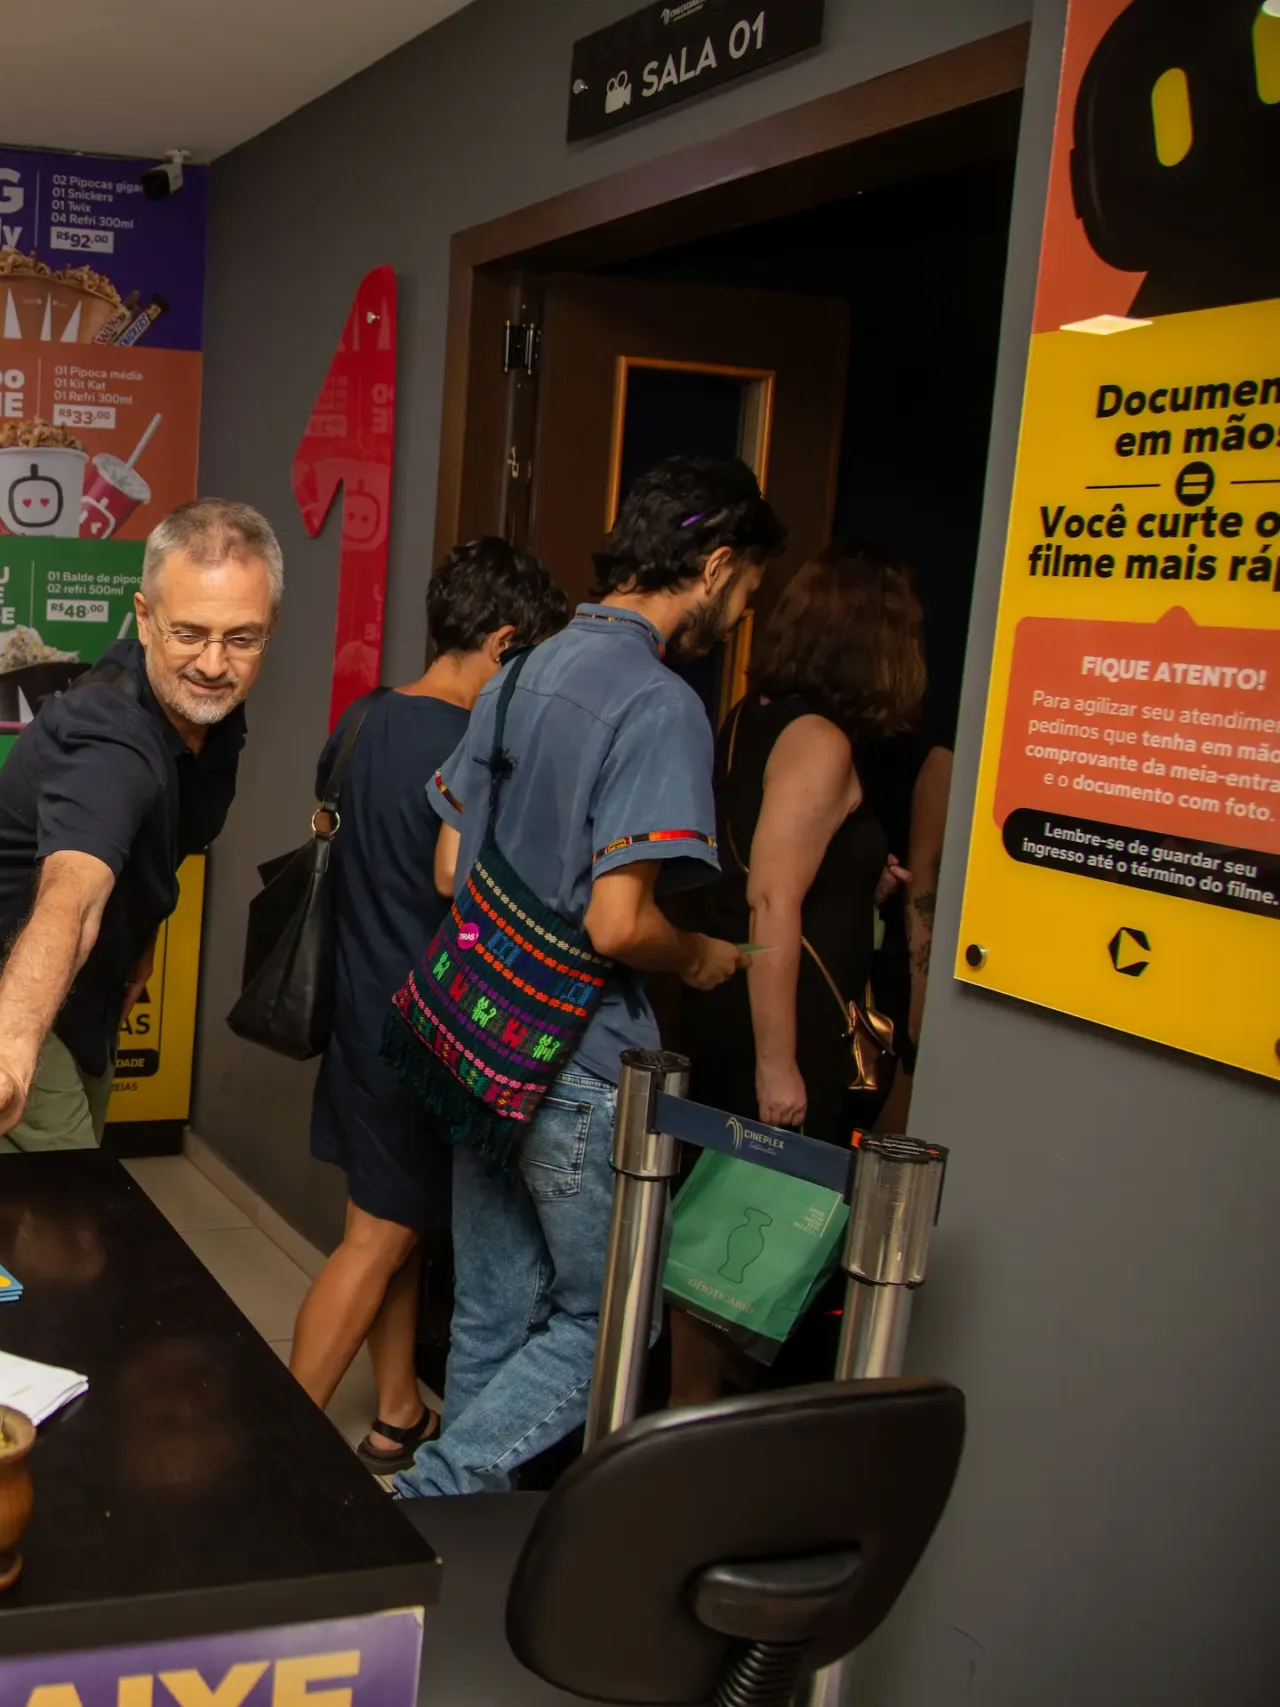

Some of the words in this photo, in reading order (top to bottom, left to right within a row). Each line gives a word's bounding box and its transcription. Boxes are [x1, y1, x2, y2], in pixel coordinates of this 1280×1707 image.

[642, 36, 717, 97] SALA
[729, 11, 765, 59] 01
[52, 174, 68, 186] 02
[69, 176, 113, 190] Pipocas
[52, 187, 65, 198] 01
[67, 188, 113, 202] Snickers
[51, 199, 65, 210] 01
[67, 201, 91, 213] Twix
[51, 212, 67, 223] 04
[69, 214, 96, 226] Refri
[99, 216, 134, 229] 300ml
[56, 231, 109, 249] R$92,00
[55, 365, 68, 375] 01
[70, 366, 107, 378] Pipoca
[110, 370, 144, 380] média
[54, 378, 67, 388] 01
[69, 378, 85, 389] Kit
[88, 380, 106, 390] Kat
[54, 390, 67, 400] 01
[69, 391, 96, 402] Refri
[98, 393, 133, 405] 300ml
[58, 408, 111, 425] R$33,00
[1115, 428, 1172, 457] em
[1183, 412, 1280, 454] mão
[1040, 503, 1127, 538] Você
[1137, 506, 1244, 538] curte
[1255, 510, 1280, 538] o
[1028, 543, 1115, 579] filme
[1125, 543, 1218, 582] mais
[47, 570, 61, 581] 01
[63, 571, 95, 583] Balde
[97, 573, 111, 583] de
[47, 583, 62, 593] 02
[64, 584, 87, 594] refri
[89, 584, 124, 595] 500ml
[51, 602, 105, 619] R$48,00
[1081, 655, 1151, 683] FIQUE
[1152, 662, 1268, 691] ATENTO!
[1032, 690, 1070, 709] Para
[1073, 696, 1138, 717] agilizar
[1141, 705, 1175, 722] seu
[1028, 718, 1100, 740] pedimos
[1103, 728, 1138, 746] que
[1142, 730, 1198, 753] tenha
[1201, 740, 1233, 757] em
[1025, 744, 1139, 772] comprovante
[1141, 757, 1167, 777] da
[1169, 763, 1280, 793] meia-entra
[1043, 772, 1055, 785] e
[1057, 775, 1069, 787] o
[1072, 774, 1174, 805] documento
[1178, 794, 1221, 813] com
[1224, 797, 1276, 822] foto.
[1044, 821, 1125, 852] Lembre-se
[1127, 839, 1150, 856] de
[1151, 846, 1222, 871] guardar
[1223, 861, 1258, 878] seu
[1022, 837, 1085, 864] ingresso
[1086, 854, 1115, 870] até
[1116, 861, 1128, 873] o
[1130, 861, 1197, 887] término
[1199, 875, 1224, 893] do
[1226, 880, 1280, 906] filme.
[744, 1129, 785, 1149] CINEPLEX
